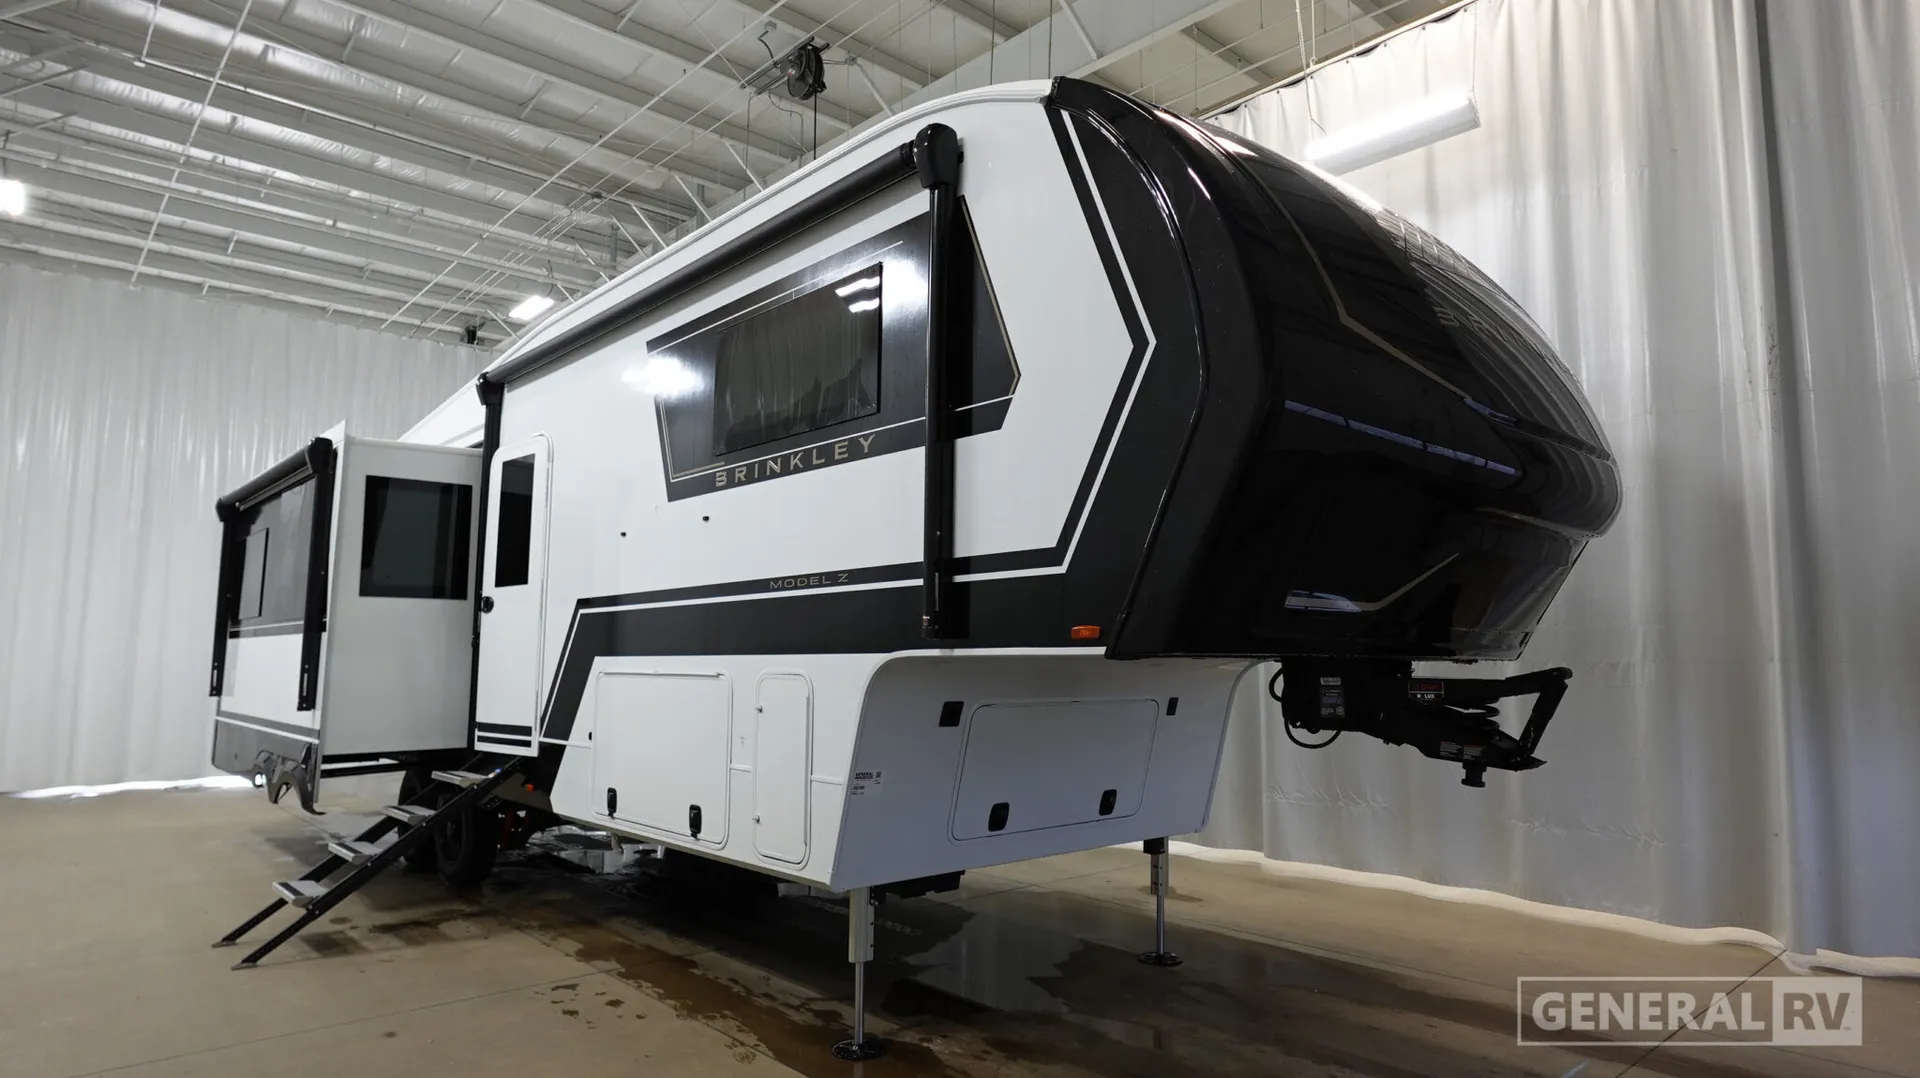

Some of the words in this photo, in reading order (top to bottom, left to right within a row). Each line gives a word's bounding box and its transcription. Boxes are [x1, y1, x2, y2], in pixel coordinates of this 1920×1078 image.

[715, 434, 876, 487] BRINKLEY
[769, 575, 832, 589] MODEL
[837, 573, 849, 583] Z
